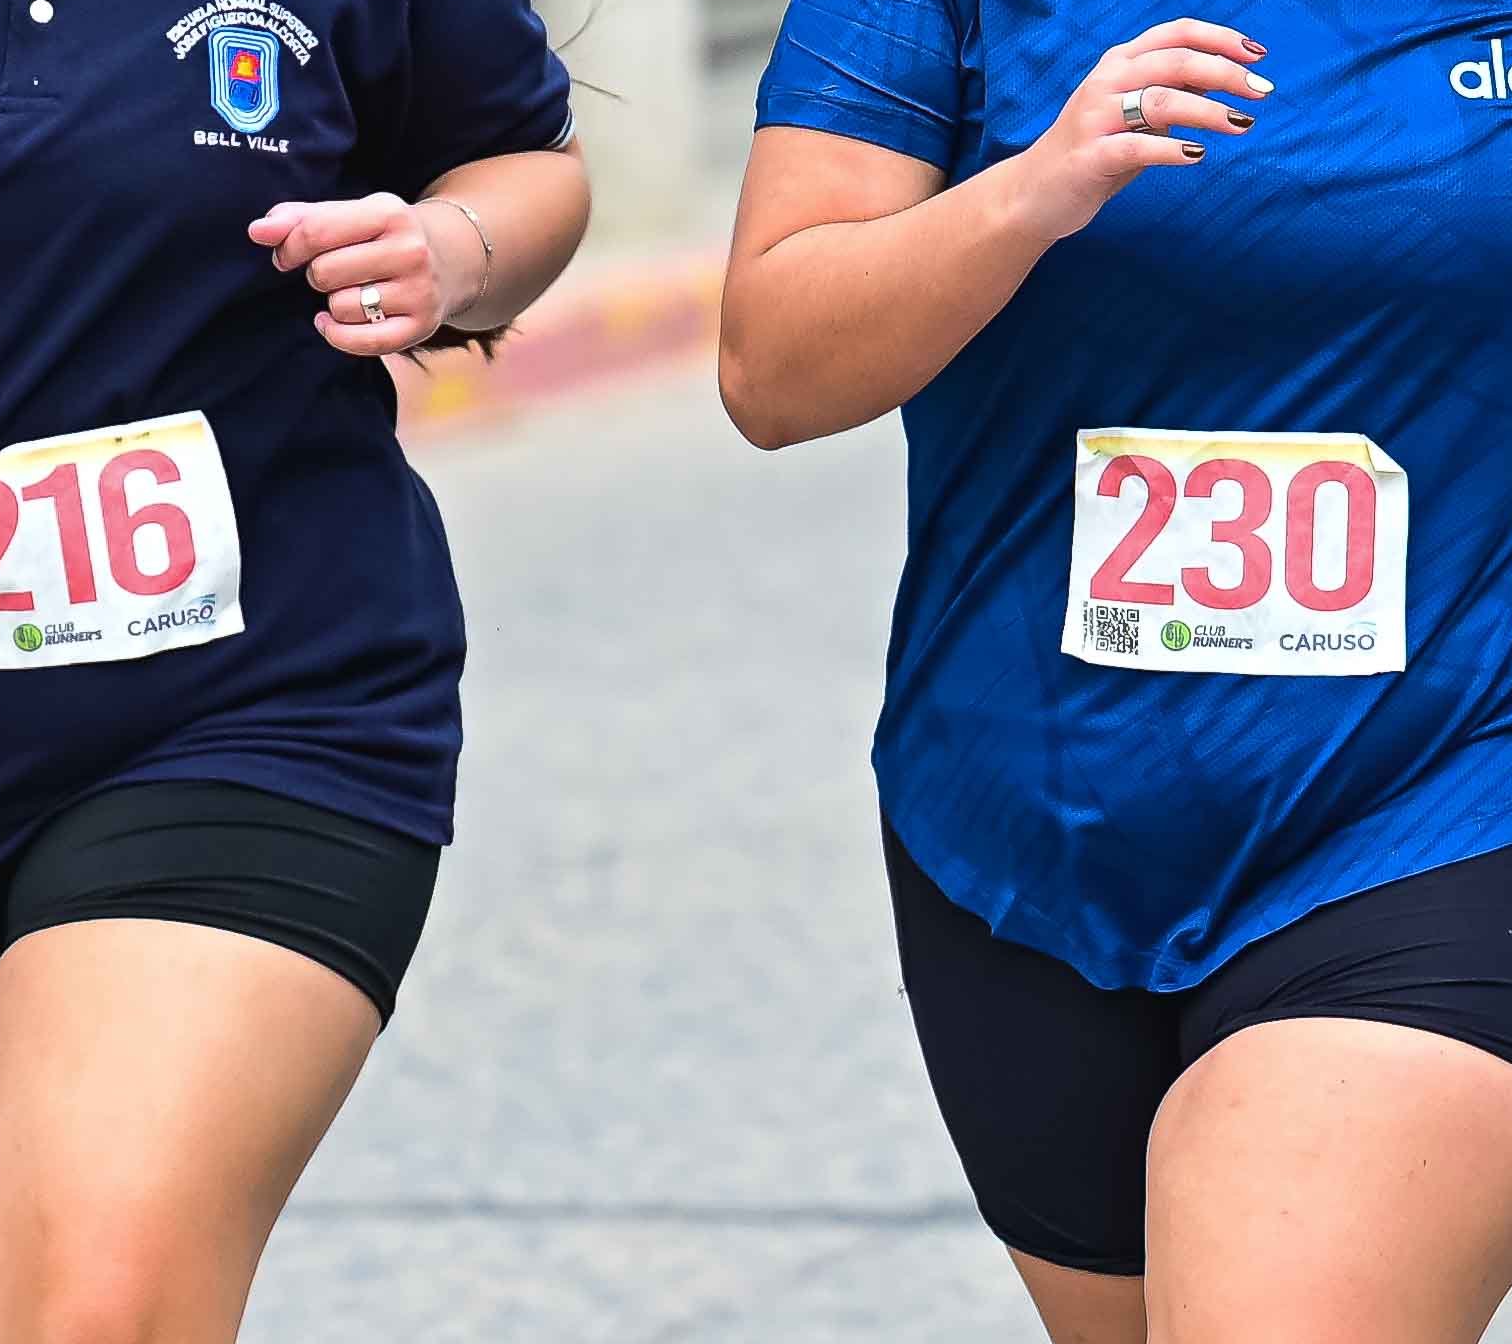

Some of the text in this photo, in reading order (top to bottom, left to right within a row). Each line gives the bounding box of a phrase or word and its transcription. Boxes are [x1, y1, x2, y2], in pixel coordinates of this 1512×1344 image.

[194, 130, 290, 153] BELL VILLE
[1089, 454, 1377, 612] 230
[44, 621, 75, 635] CLUB
[127, 604, 214, 636] CARUSO
[1194, 624, 1226, 637] CLUB
[1192, 636, 1254, 650] RUNNER'S
[1279, 633, 1375, 652] CARUSO
